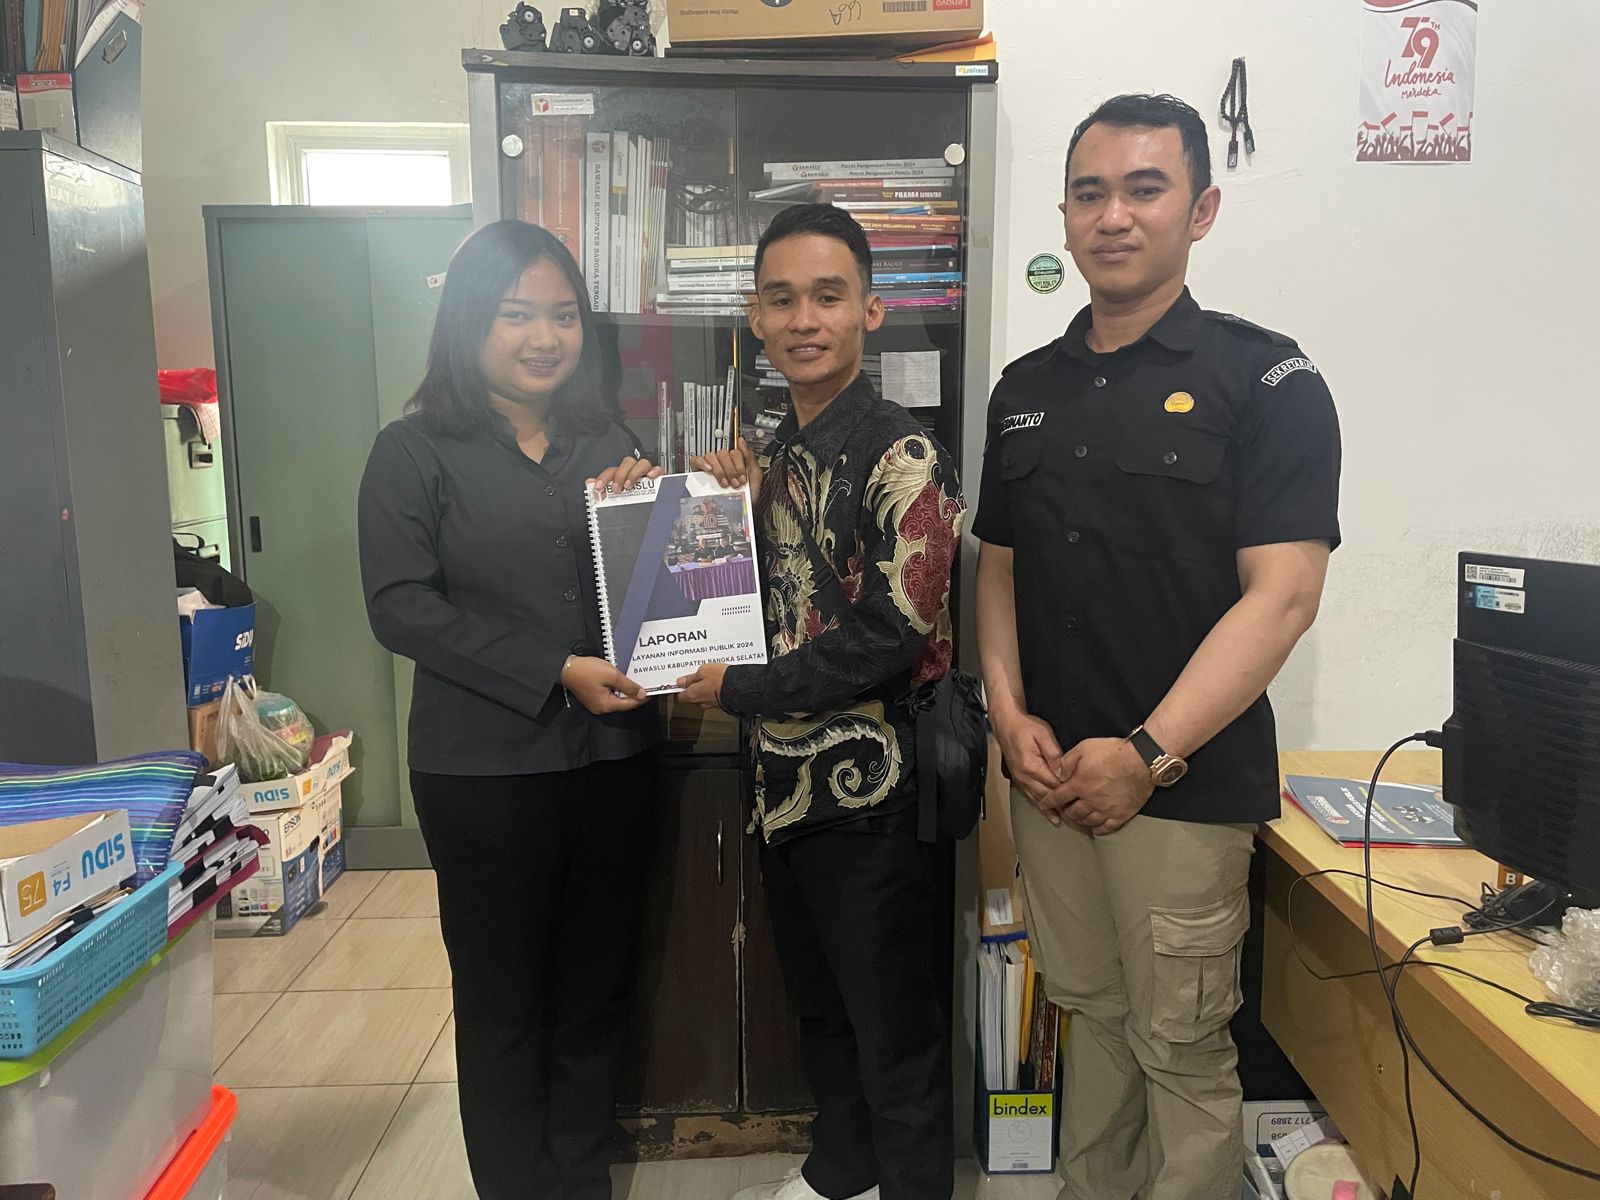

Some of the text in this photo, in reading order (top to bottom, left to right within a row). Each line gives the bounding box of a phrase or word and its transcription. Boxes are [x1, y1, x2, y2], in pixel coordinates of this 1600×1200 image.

[1384, 59, 1456, 88] Indonesia
[638, 629, 708, 648] LAPORAN
[632, 641, 754, 662] LAYANAN INFORMASI PUBLIK 2024
[633, 663, 667, 674] BAWASLU
[667, 659, 706, 670] KABUPATEN
[707, 656, 735, 665] BANGKA
[81, 831, 127, 878] SiDU
[52, 872, 71, 896] F4
[993, 1097, 1047, 1115] bindex
[1271, 1117, 1292, 1126] 2889
